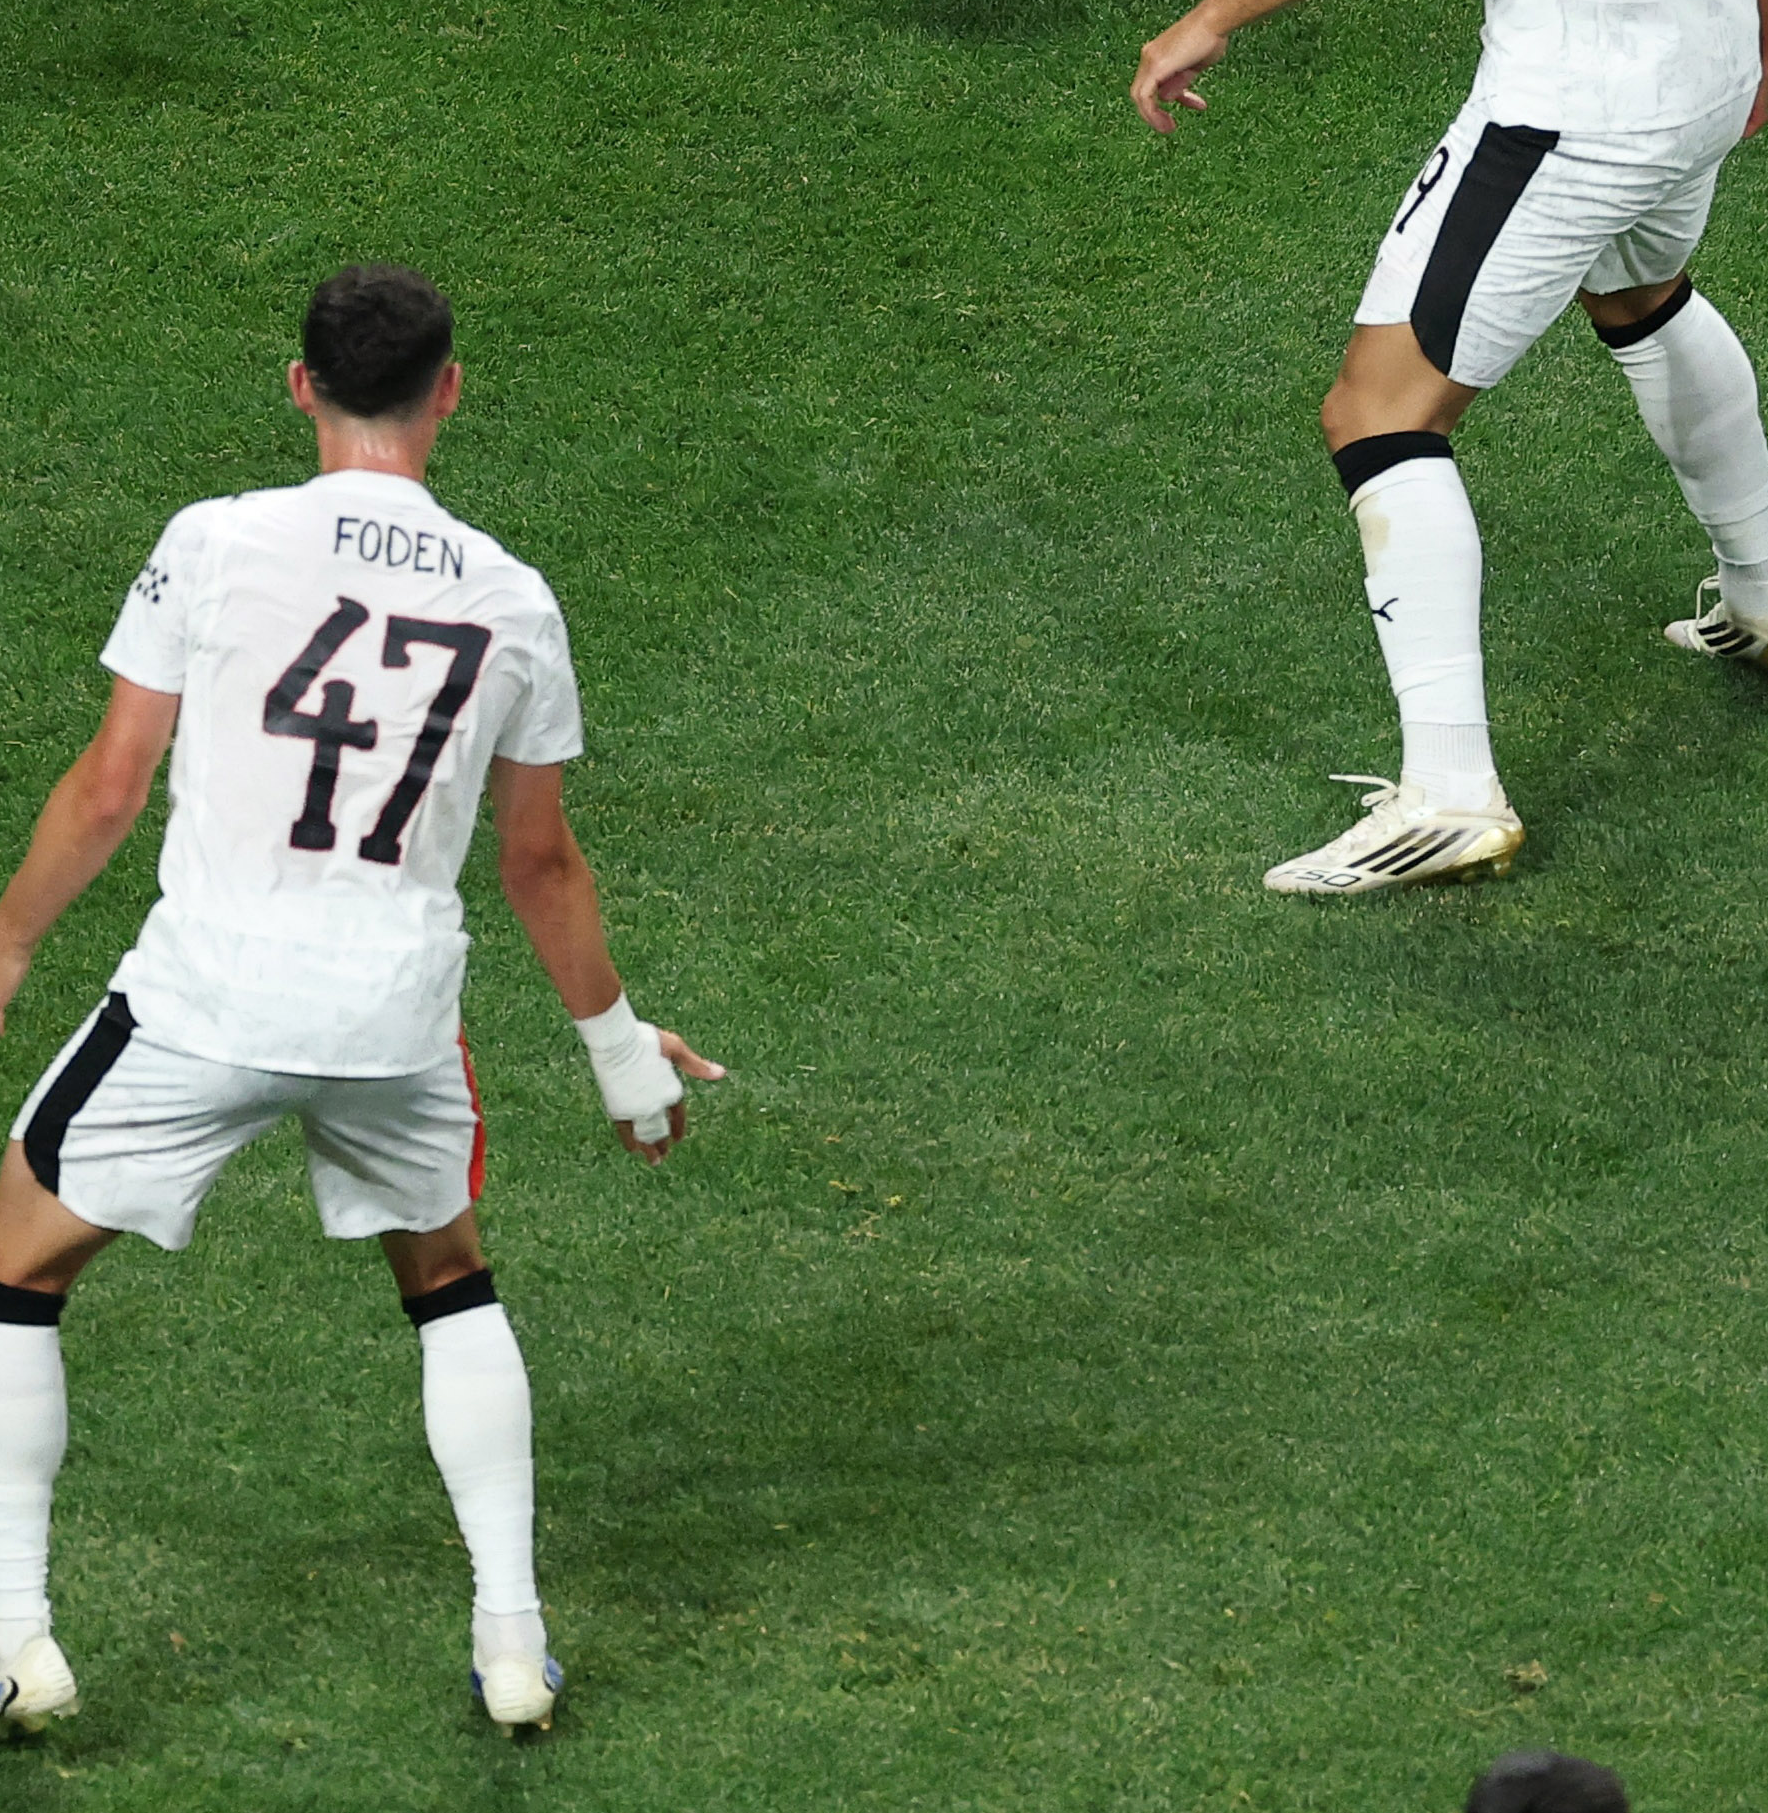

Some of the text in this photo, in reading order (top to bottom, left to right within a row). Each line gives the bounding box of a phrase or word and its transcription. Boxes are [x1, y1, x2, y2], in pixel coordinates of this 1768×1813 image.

[1395, 145, 1450, 235] 9
[333, 516, 464, 579] FODEN
[263, 595, 493, 866] 47
